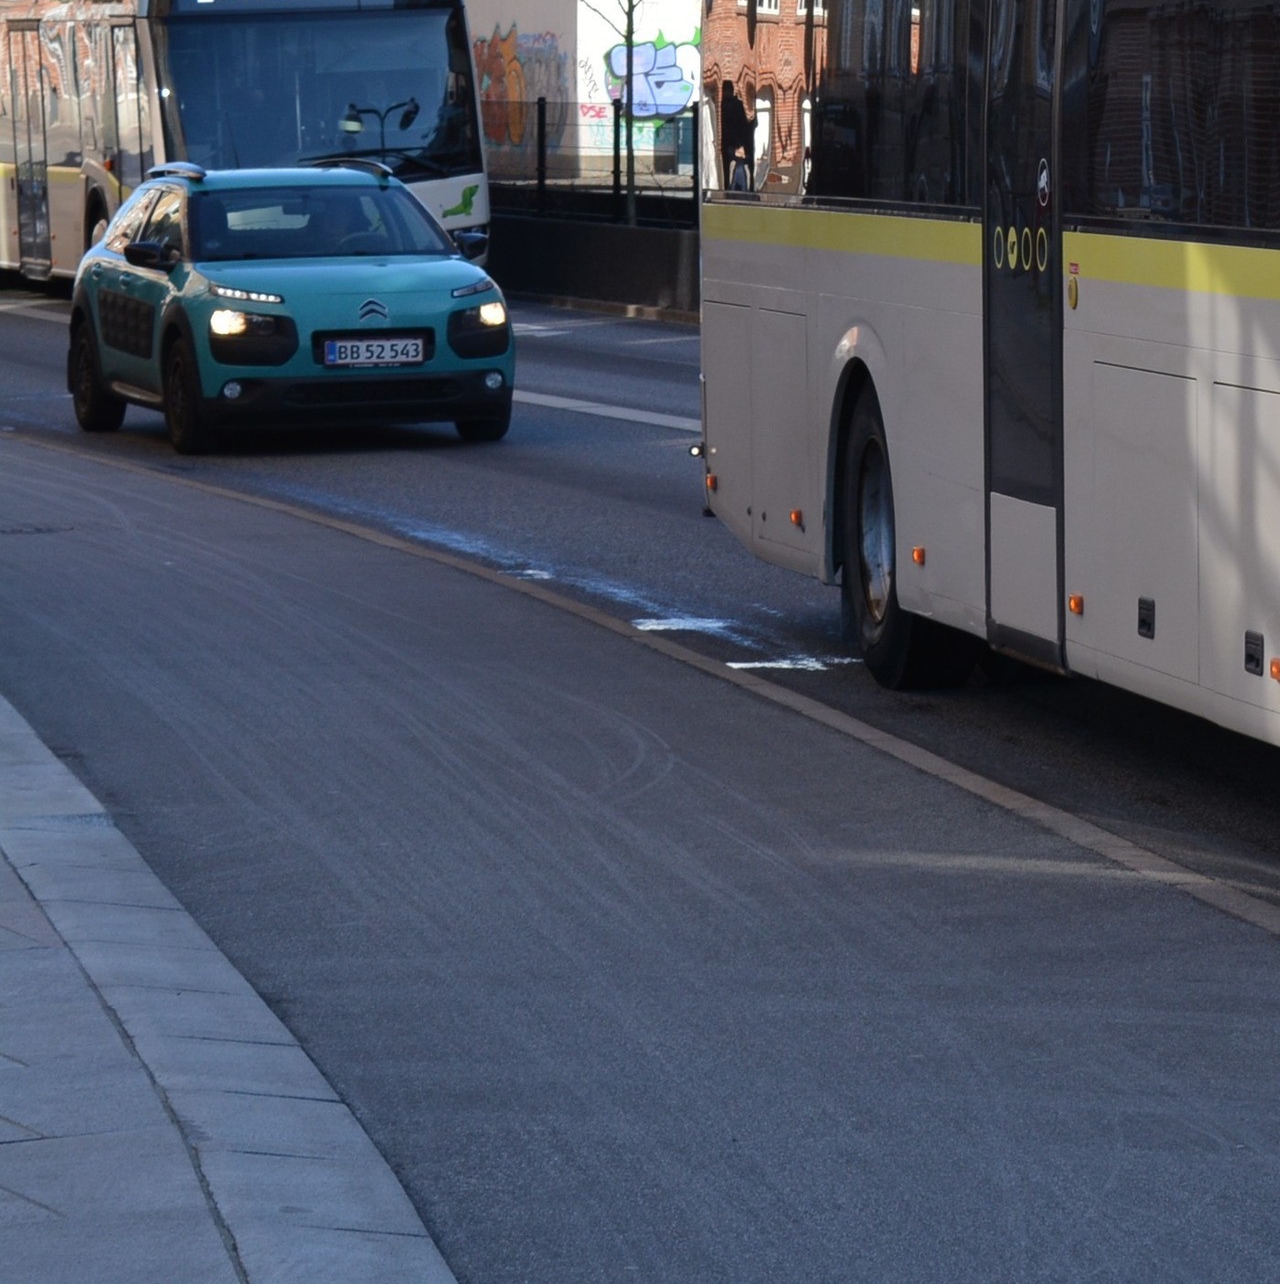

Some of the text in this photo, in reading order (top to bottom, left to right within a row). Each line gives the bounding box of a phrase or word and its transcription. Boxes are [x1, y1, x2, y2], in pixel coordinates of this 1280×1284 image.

[338, 343, 420, 360] BB 52 543
